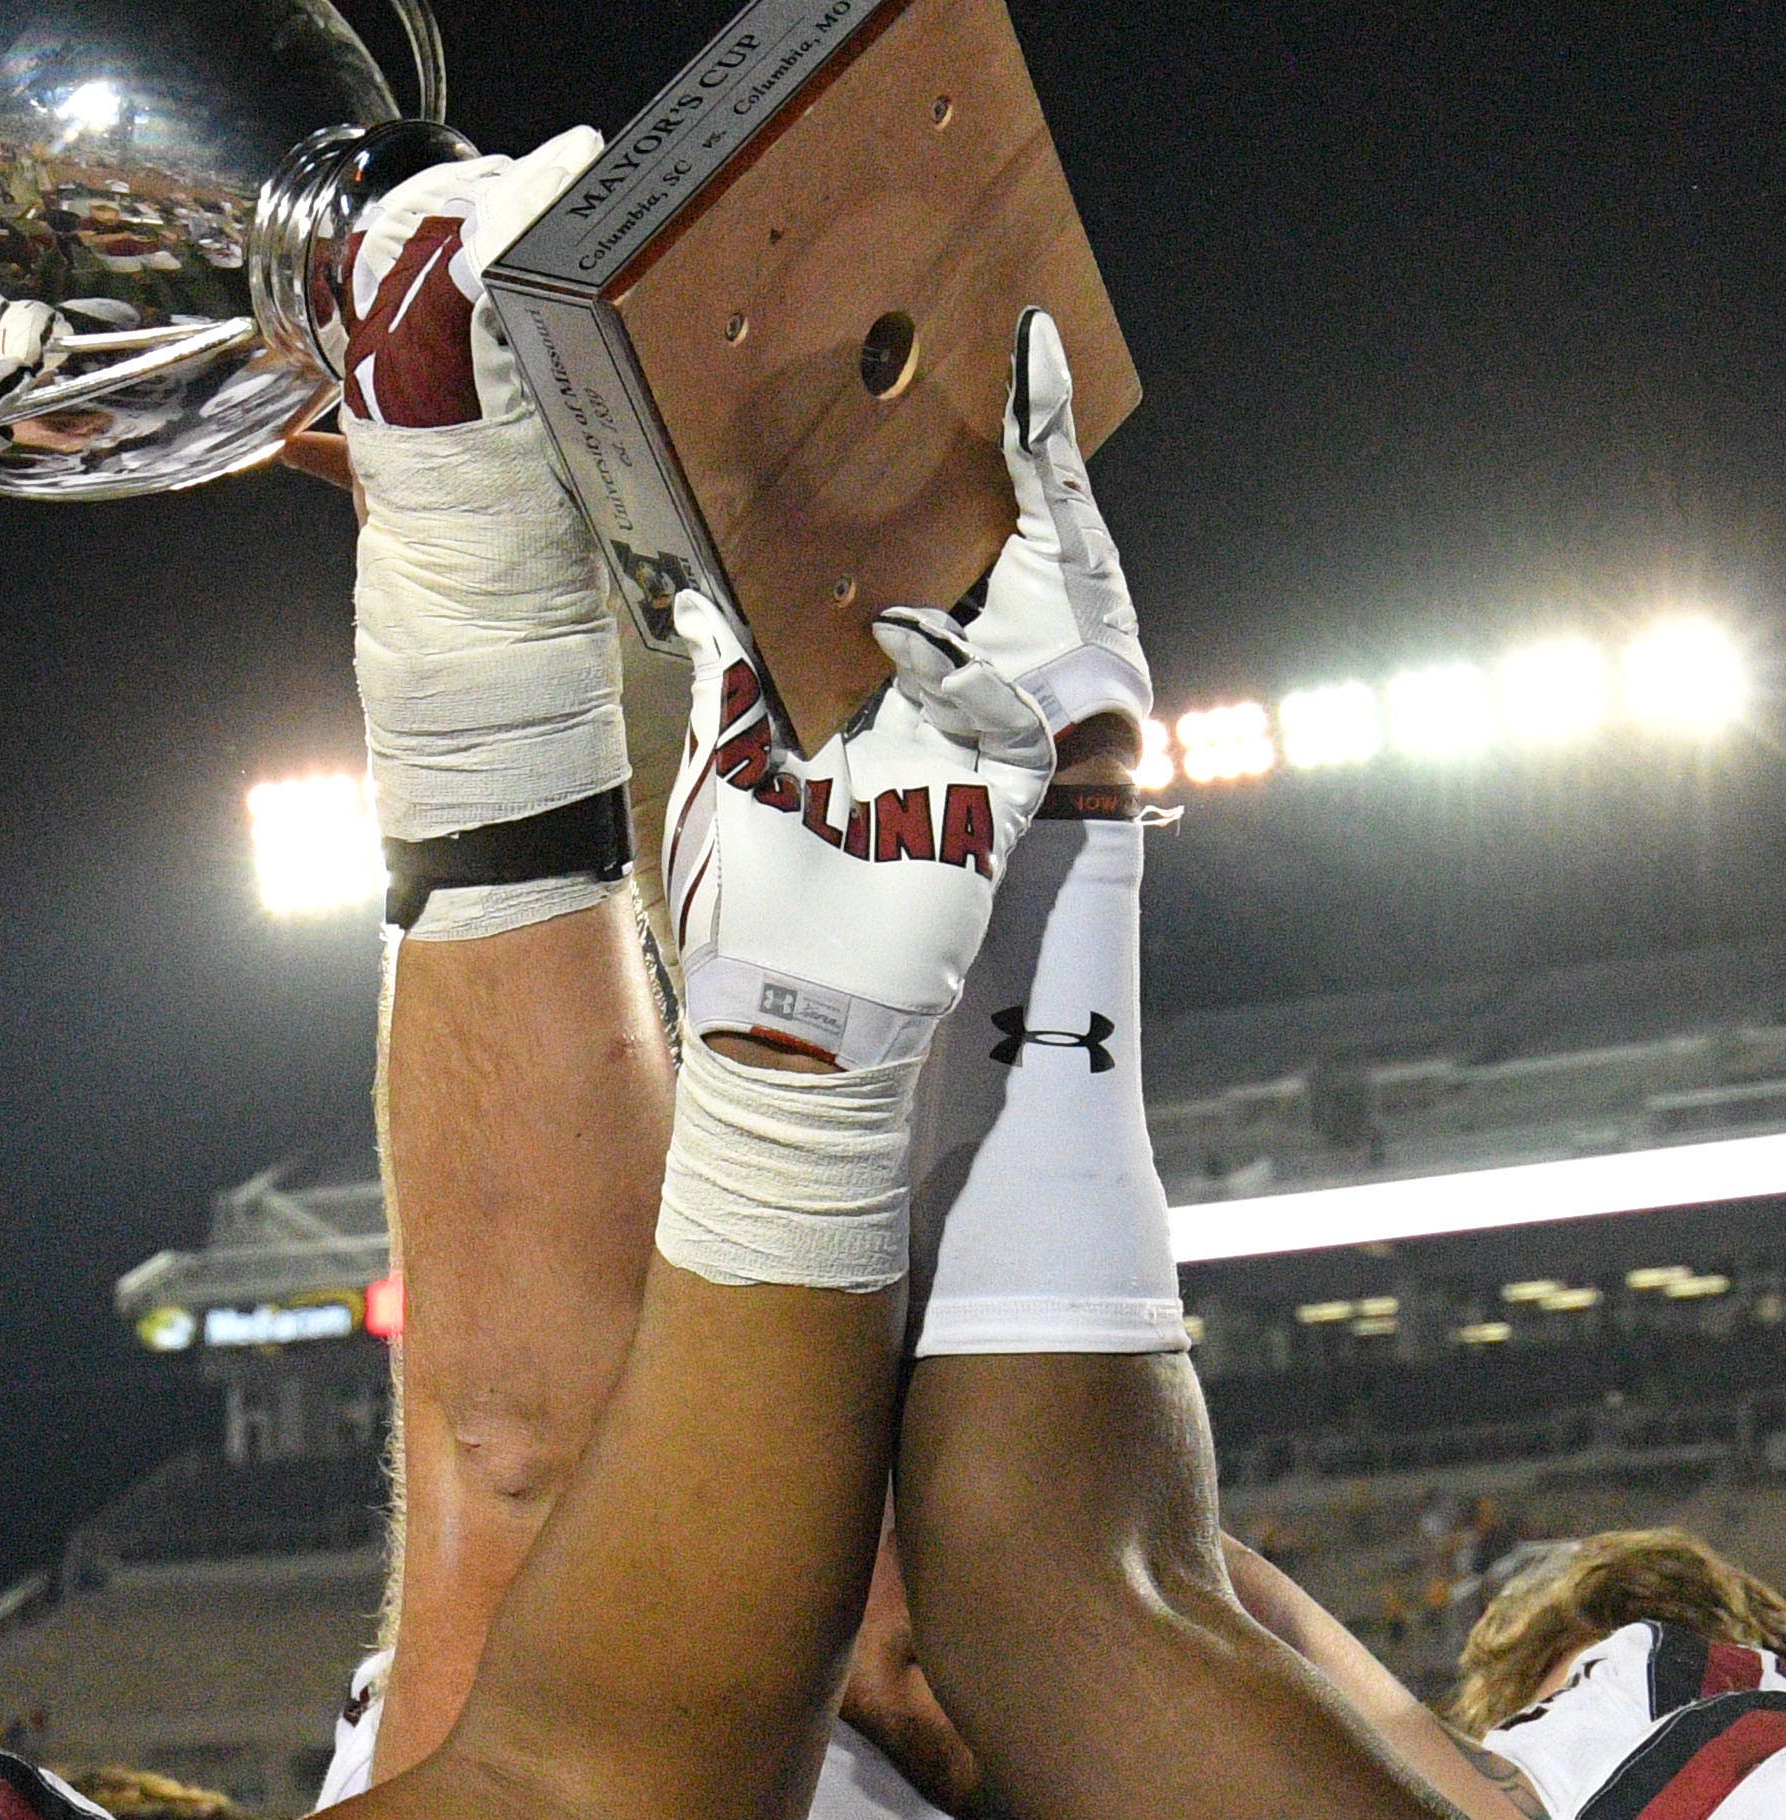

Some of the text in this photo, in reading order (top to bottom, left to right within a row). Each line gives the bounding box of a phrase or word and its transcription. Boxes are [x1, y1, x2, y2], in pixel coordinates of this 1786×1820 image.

[569, 33, 762, 220] MAYOR'S CUP
[578, 0, 852, 272] Columbia, SC vs. Columbia, MO
[524, 307, 634, 531] University of Missouri
